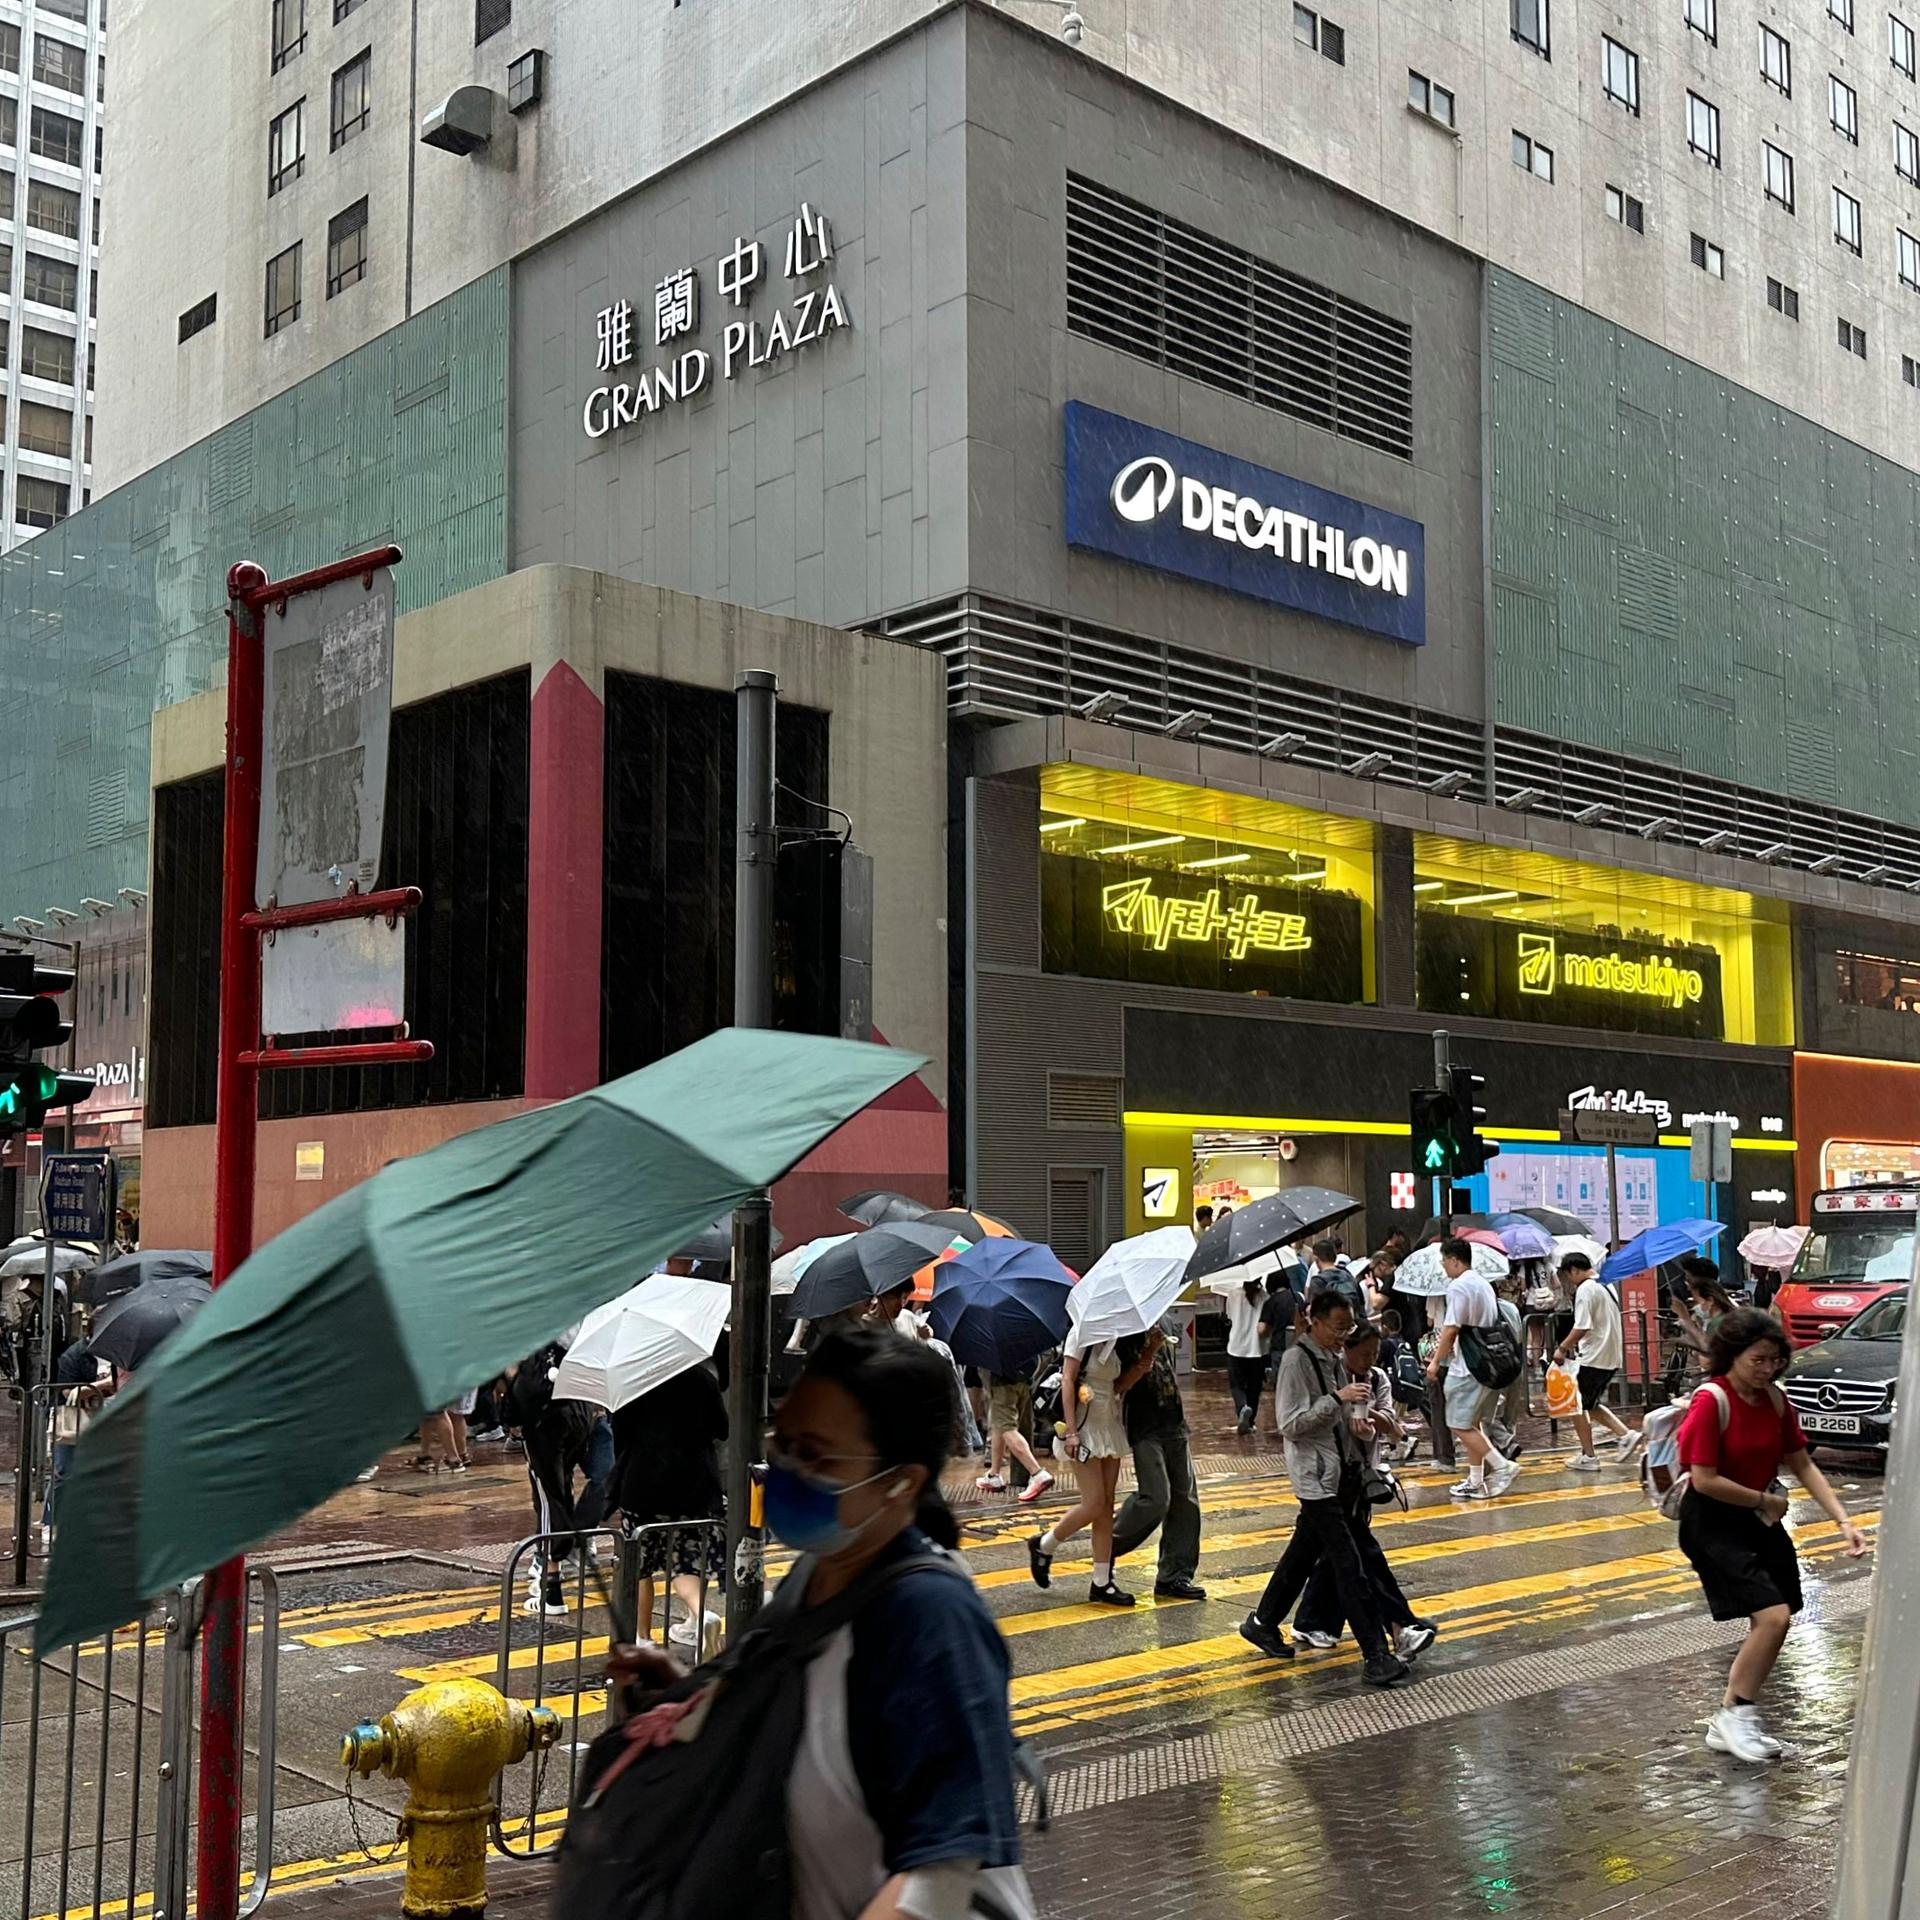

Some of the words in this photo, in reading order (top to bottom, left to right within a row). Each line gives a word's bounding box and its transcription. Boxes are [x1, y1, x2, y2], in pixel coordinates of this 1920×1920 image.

[596, 202, 832, 371] 雅蘭中心
[583, 349, 709, 438] GRAND
[724, 283, 849, 379] PLAZA
[1181, 476, 1408, 597] DECATHLON
[1564, 953, 1703, 1008] matsukiyo
[96, 1062, 129, 1087] PLAZA
[1826, 1194, 1919, 1210] 富豪雪
[1820, 1418, 1856, 1431] 2268
